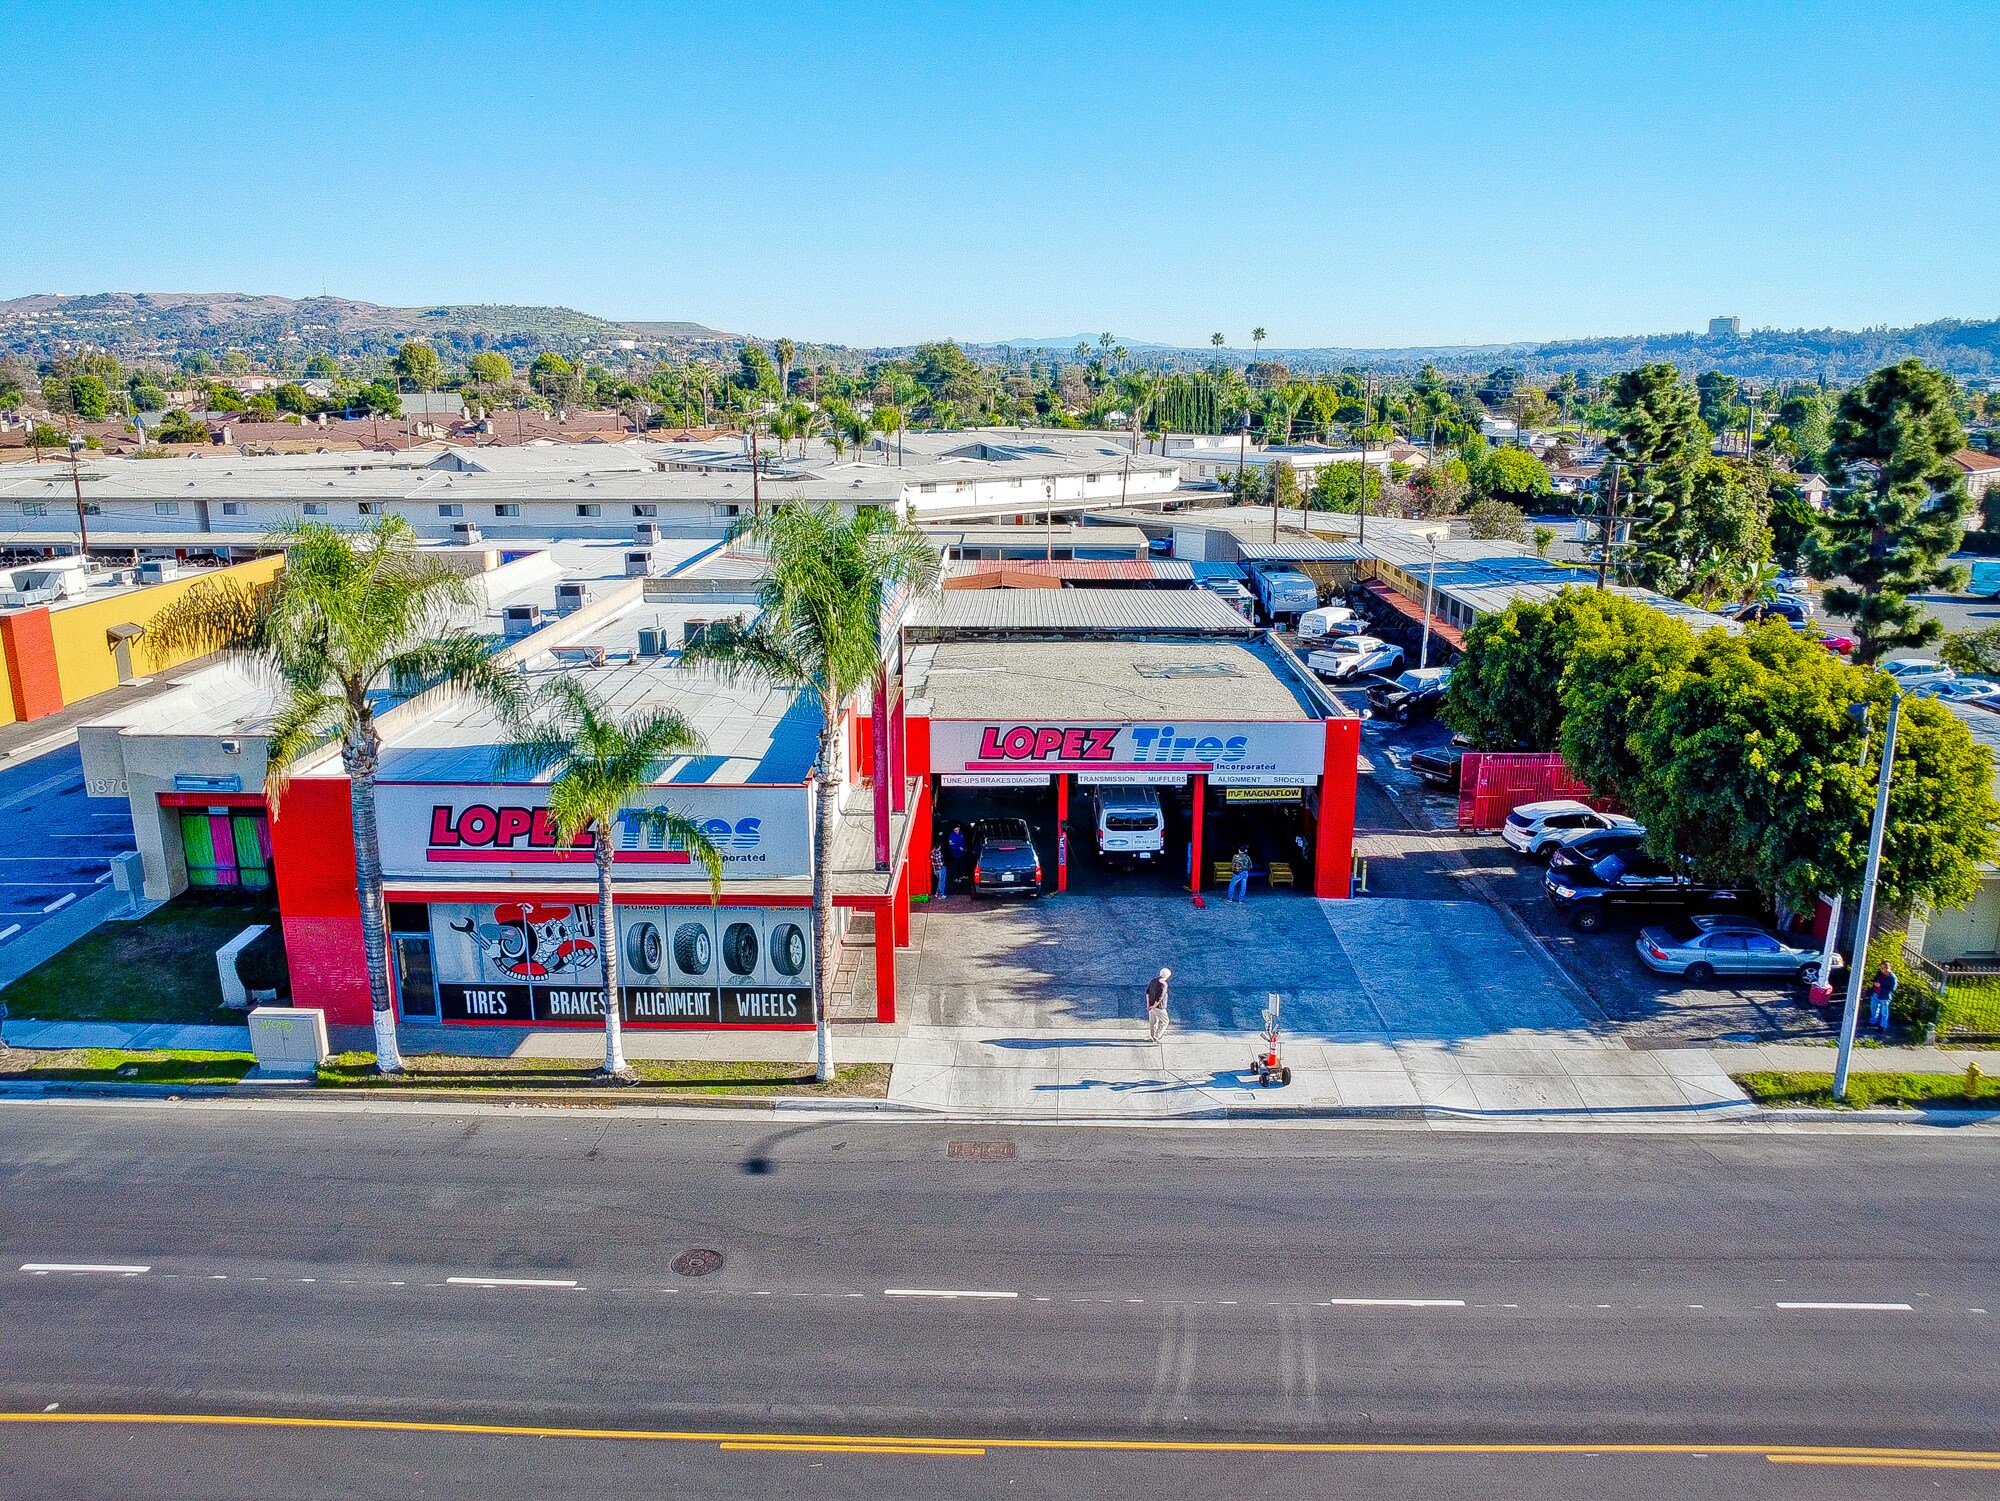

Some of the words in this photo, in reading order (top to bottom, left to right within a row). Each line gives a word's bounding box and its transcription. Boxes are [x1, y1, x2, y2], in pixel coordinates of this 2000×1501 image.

[978, 726, 1122, 760] LOPEZ
[1131, 726, 1249, 762] Tires
[1216, 763, 1276, 772] Incorporated
[980, 776, 1011, 784] BRAKES
[1011, 776, 1050, 784] DIAGNOSIS
[1273, 776, 1305, 784] SHOCKS
[1243, 789, 1300, 797] MAGNAFLOW
[692, 853, 766, 863] Iporated
[463, 990, 508, 1015] TIRES
[549, 991, 607, 1015] BRAKES
[635, 991, 711, 1017] ALIGNMENT
[736, 993, 798, 1018] WHEELS
